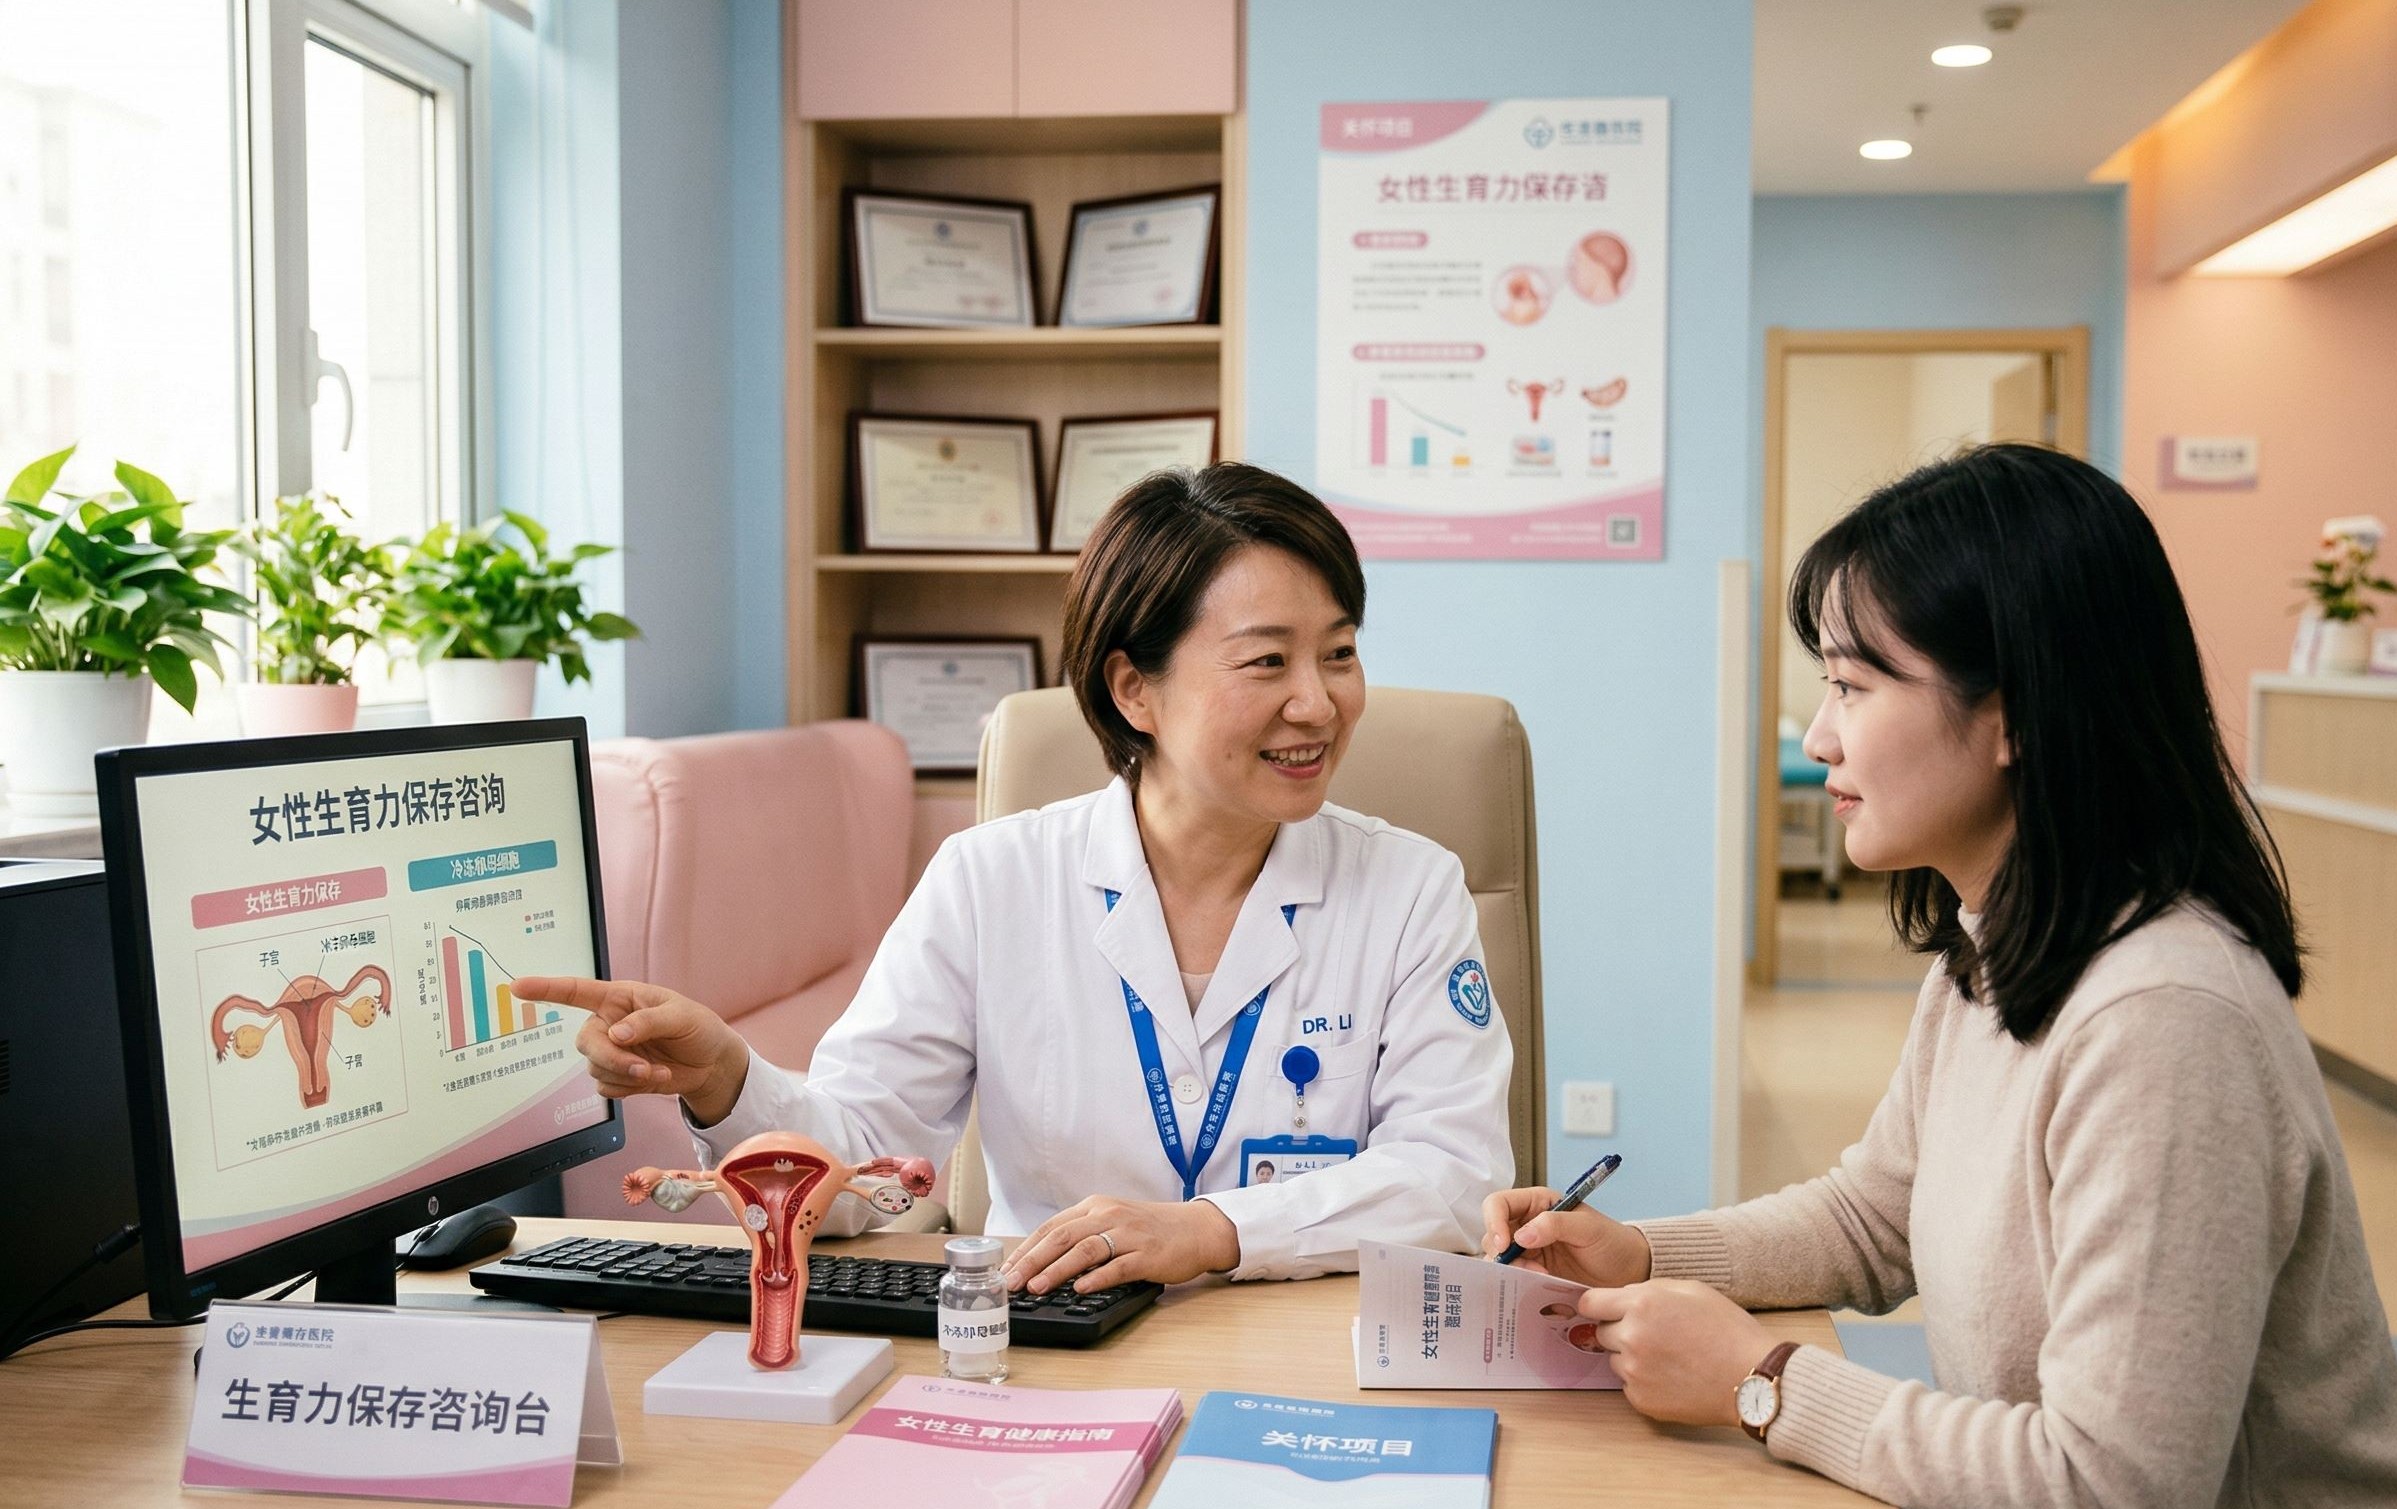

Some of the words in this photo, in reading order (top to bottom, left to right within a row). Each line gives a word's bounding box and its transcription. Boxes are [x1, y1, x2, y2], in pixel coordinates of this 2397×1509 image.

[250, 773, 506, 846] 女性生育力保存咨询
[1302, 1017, 1333, 1035] DR.
[1339, 1013, 1352, 1031] LI
[221, 1378, 551, 1437] 生育力保存咨询台
[893, 1415, 1115, 1443] 女性生育健康指南
[1260, 1429, 1414, 1457] 关怀项目
